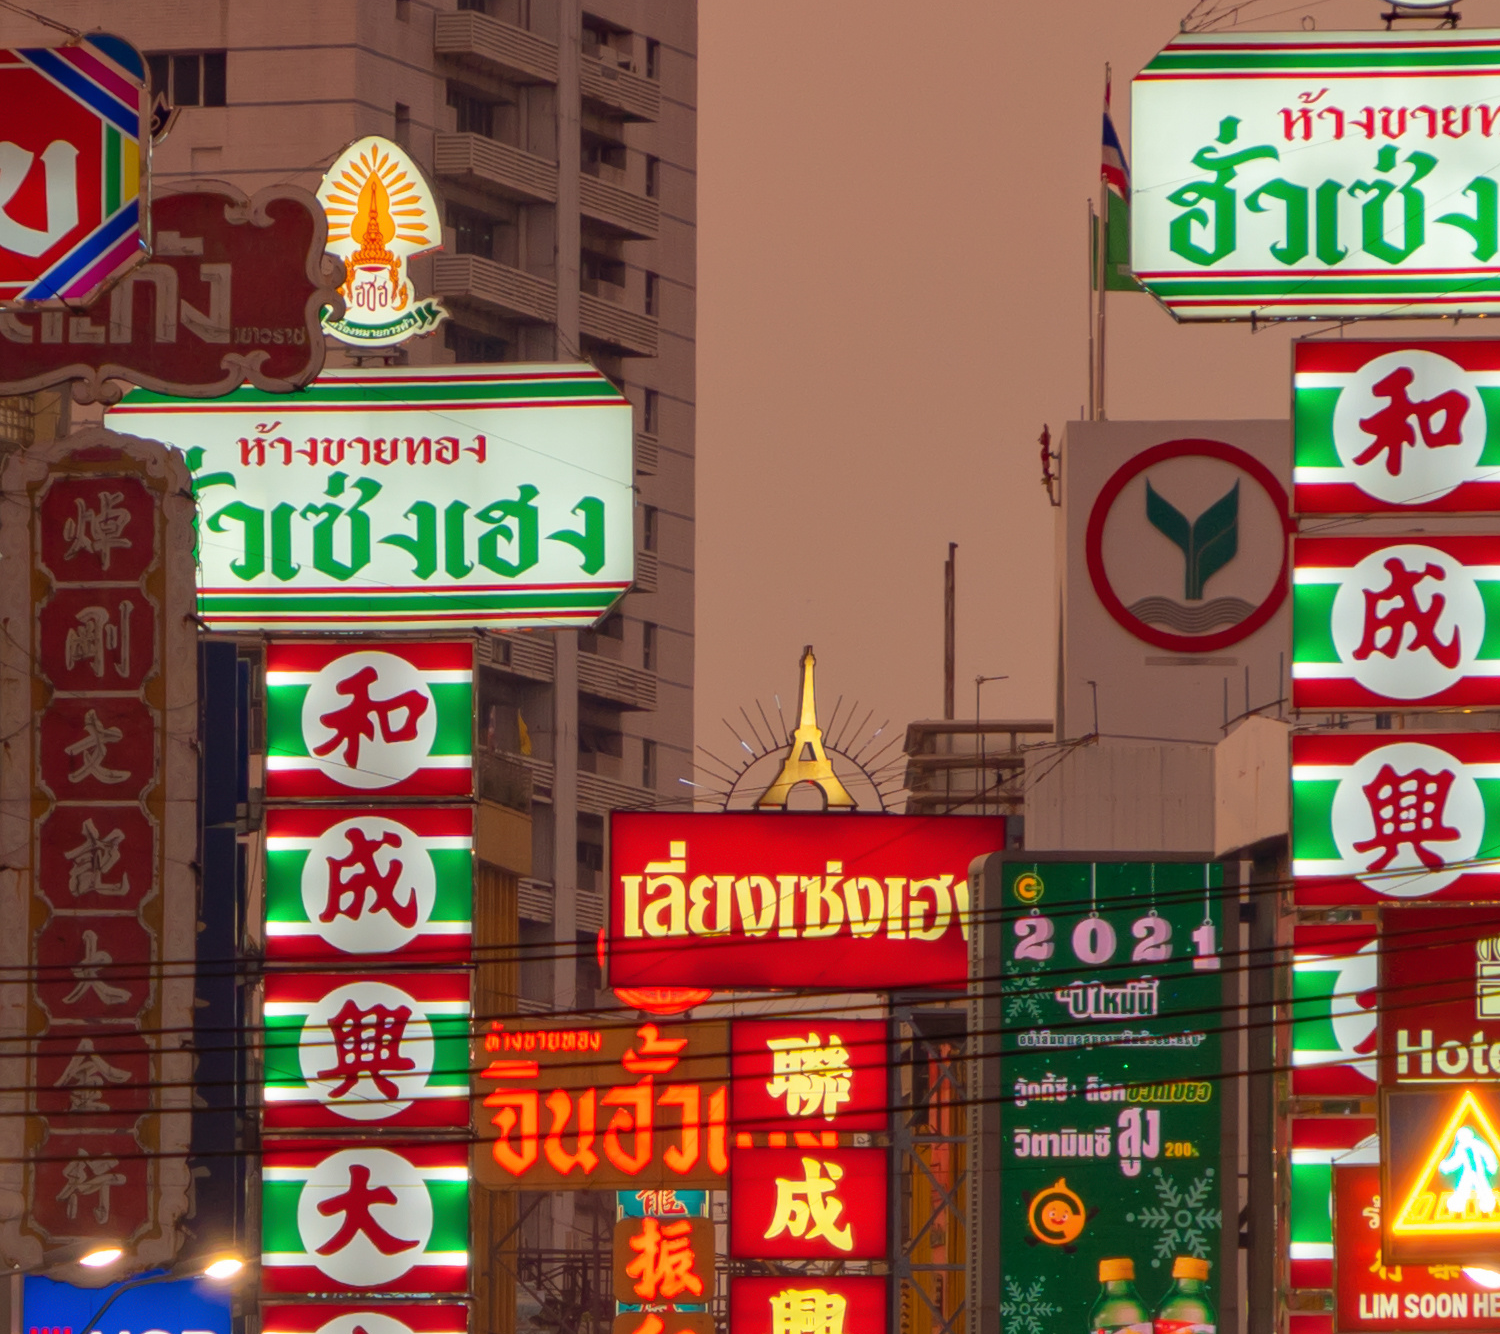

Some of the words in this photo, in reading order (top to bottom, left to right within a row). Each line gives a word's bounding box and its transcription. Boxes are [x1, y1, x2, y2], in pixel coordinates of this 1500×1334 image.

[237, 433, 488, 470] ห้างขายทอง
[1012, 912, 1222, 970] 2021
[1014, 1126, 1111, 1159] วิตามินซี
[1359, 1291, 1399, 1320] LIM
[1404, 1290, 1468, 1319] SOON
